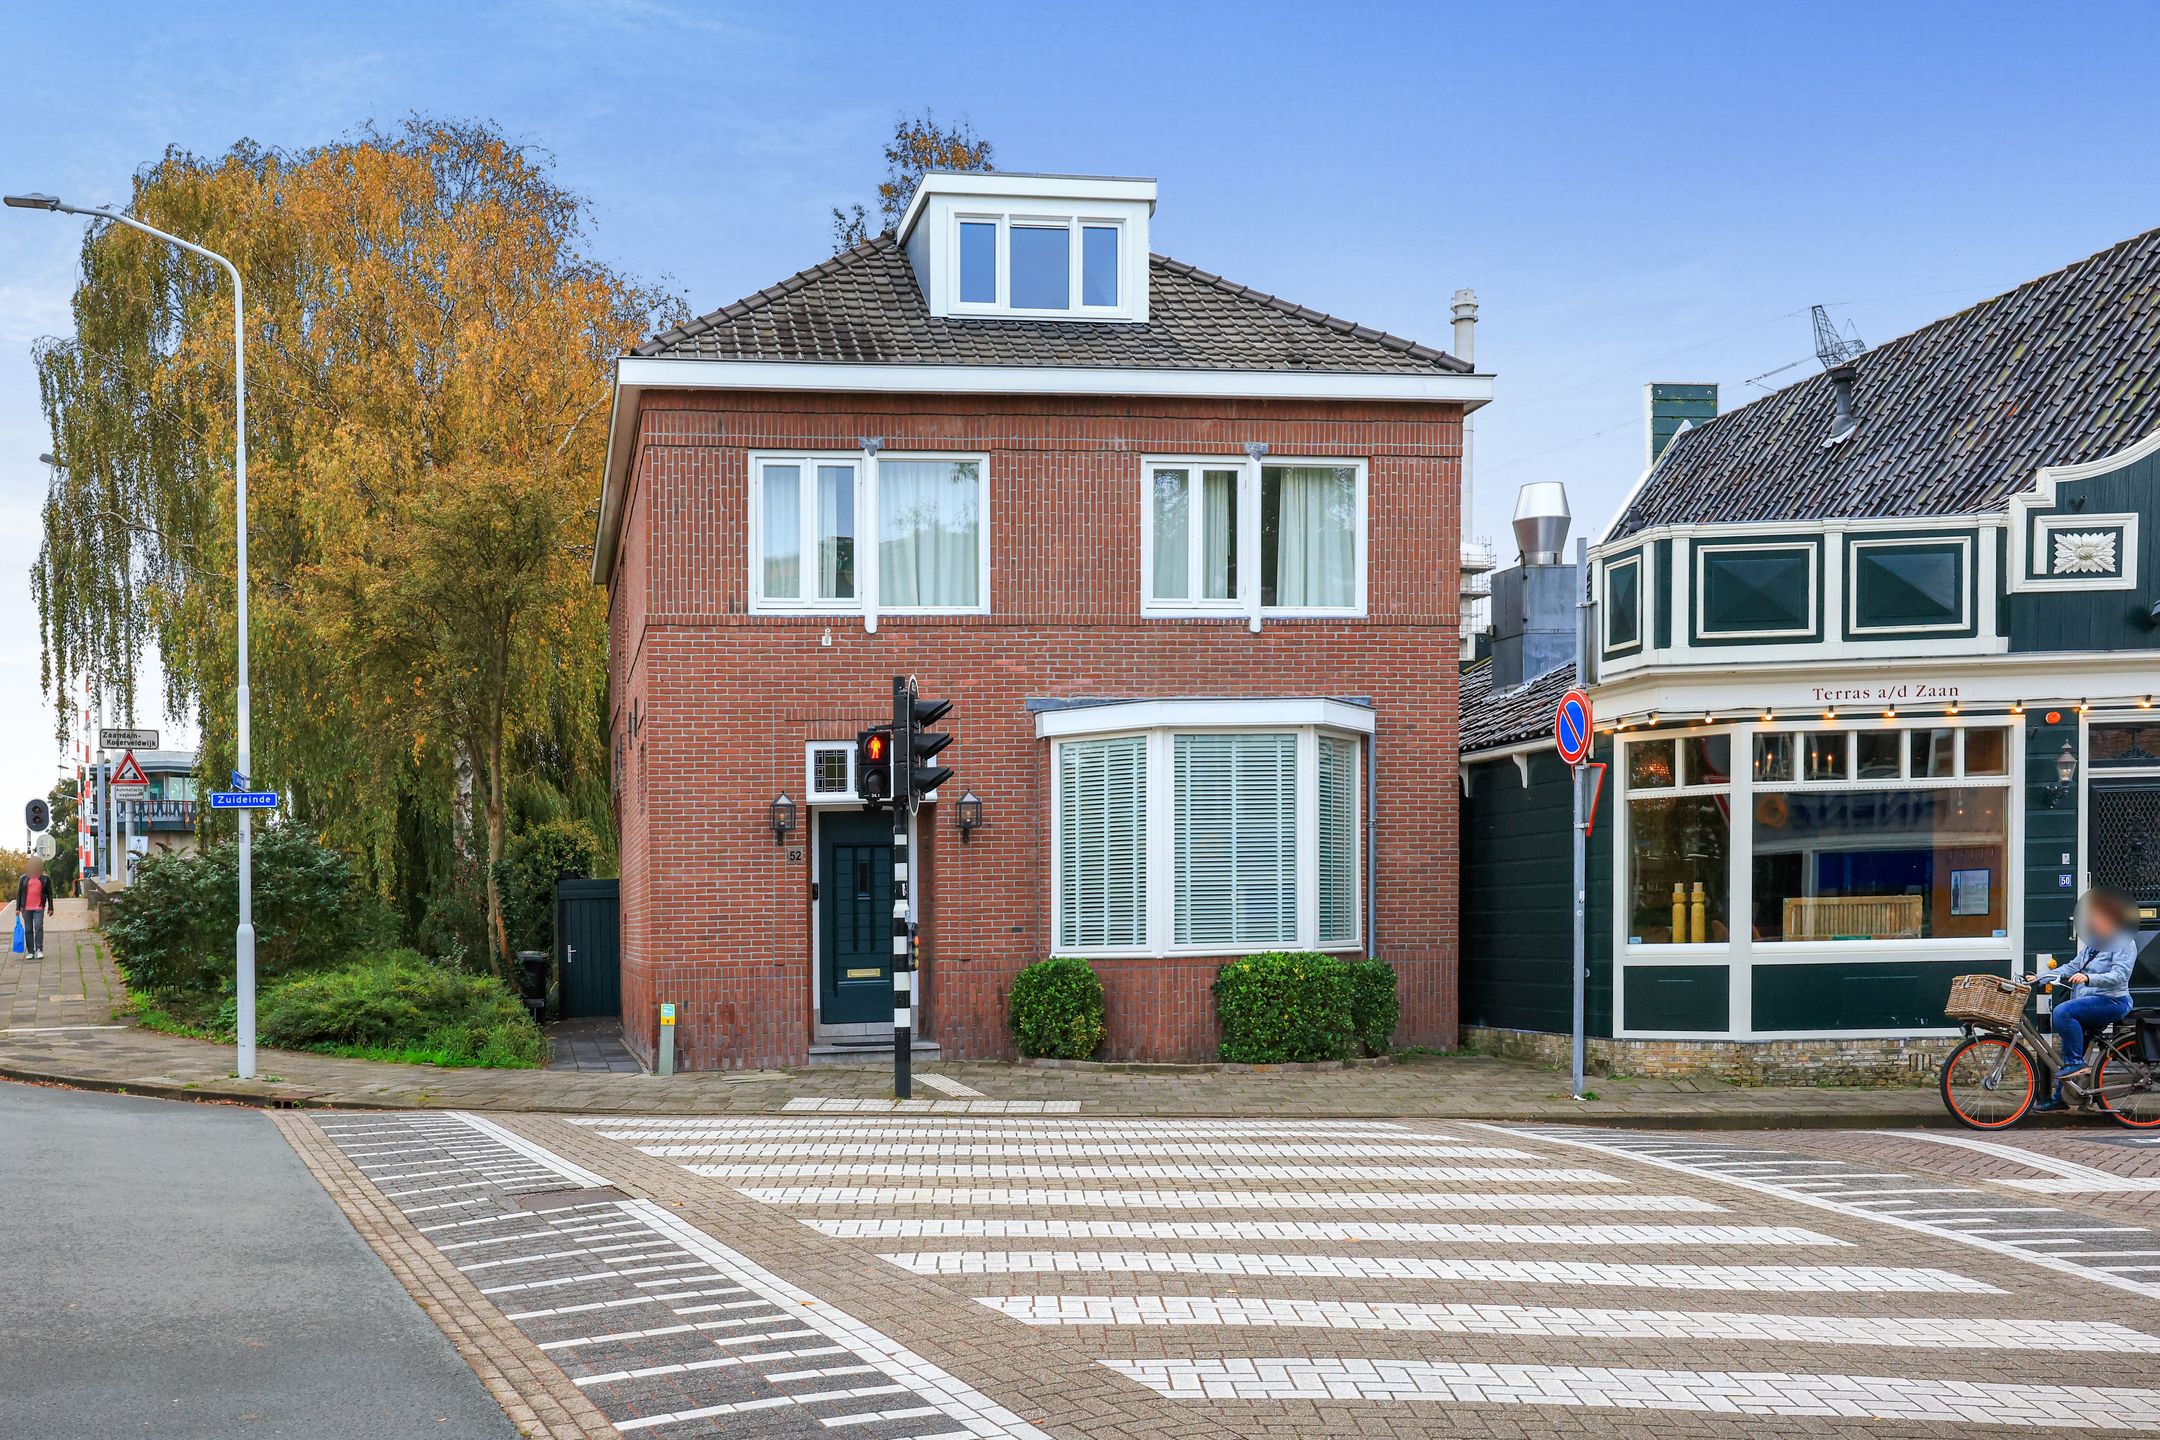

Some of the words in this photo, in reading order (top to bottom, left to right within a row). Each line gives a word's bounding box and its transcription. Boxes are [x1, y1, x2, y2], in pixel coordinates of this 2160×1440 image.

[1812, 687, 1870, 701] Terras
[1878, 685, 1907, 700] a/d
[1916, 684, 1959, 698] Zaan
[102, 731, 141, 739] Zaandam-
[217, 795, 271, 804] Zuideinde
[790, 850, 801, 861] 52
[2060, 876, 2070, 885] 50
